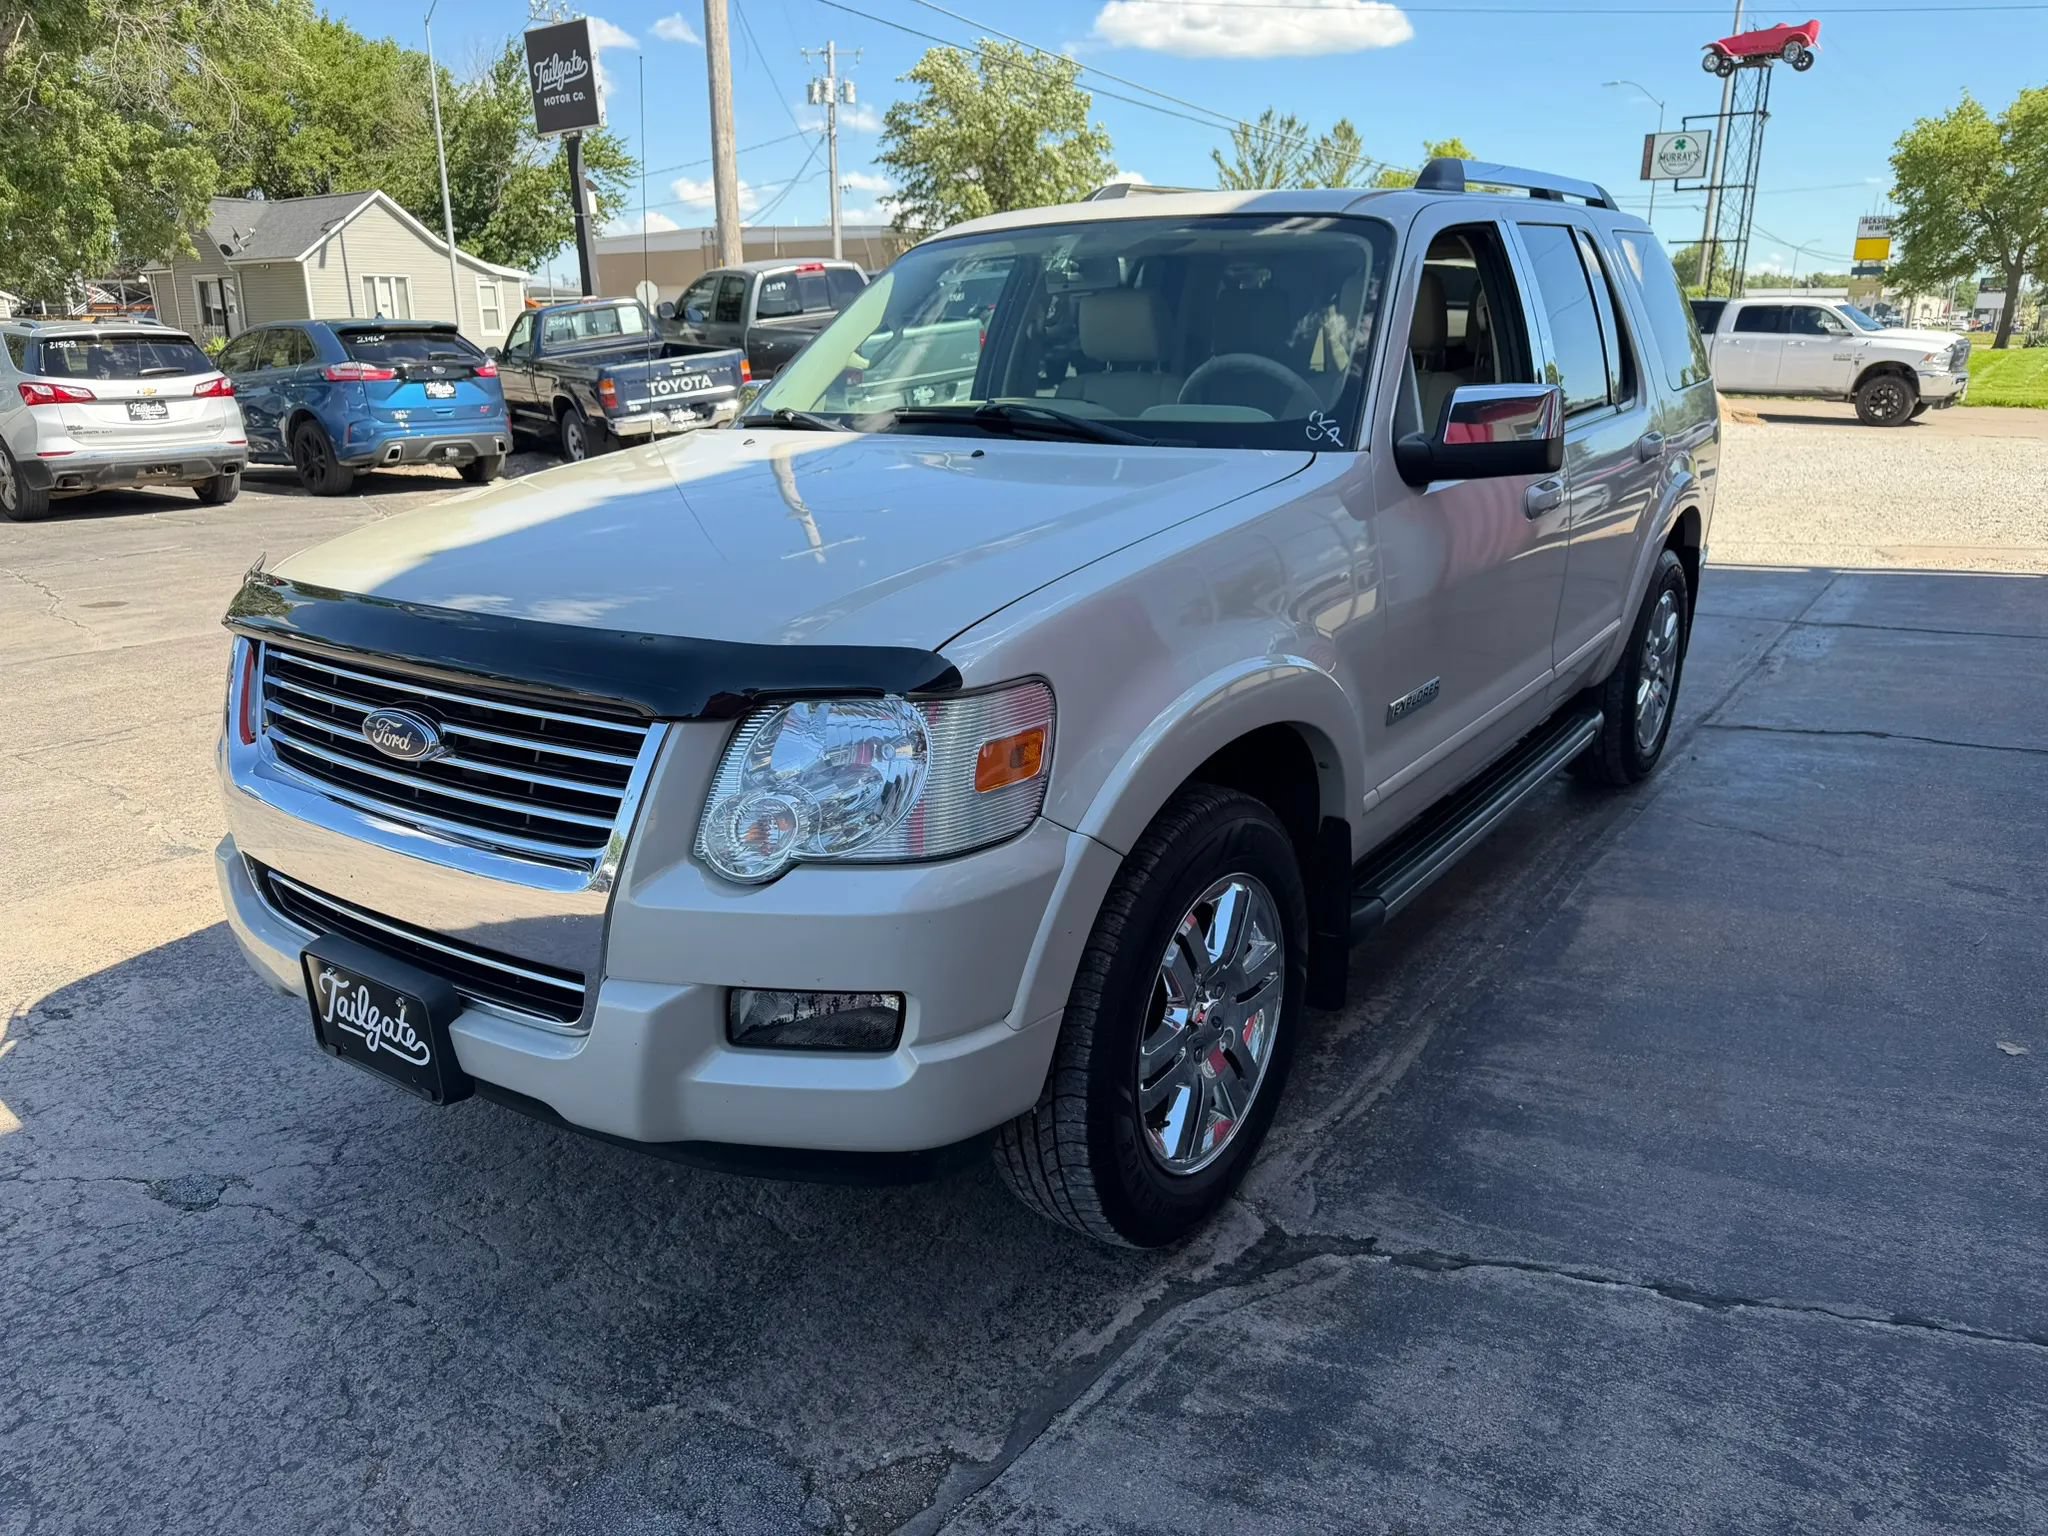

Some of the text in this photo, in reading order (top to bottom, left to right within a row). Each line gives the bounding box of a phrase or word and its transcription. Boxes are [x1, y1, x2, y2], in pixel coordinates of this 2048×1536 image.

[533, 49, 588, 94] Tailgate
[543, 91, 586, 107] MOTOR CO.
[646, 374, 713, 396] TOYOTA
[1391, 680, 1440, 718] EXPLORER
[372, 717, 413, 751] Ford
[319, 972, 431, 1066] Tailgate
